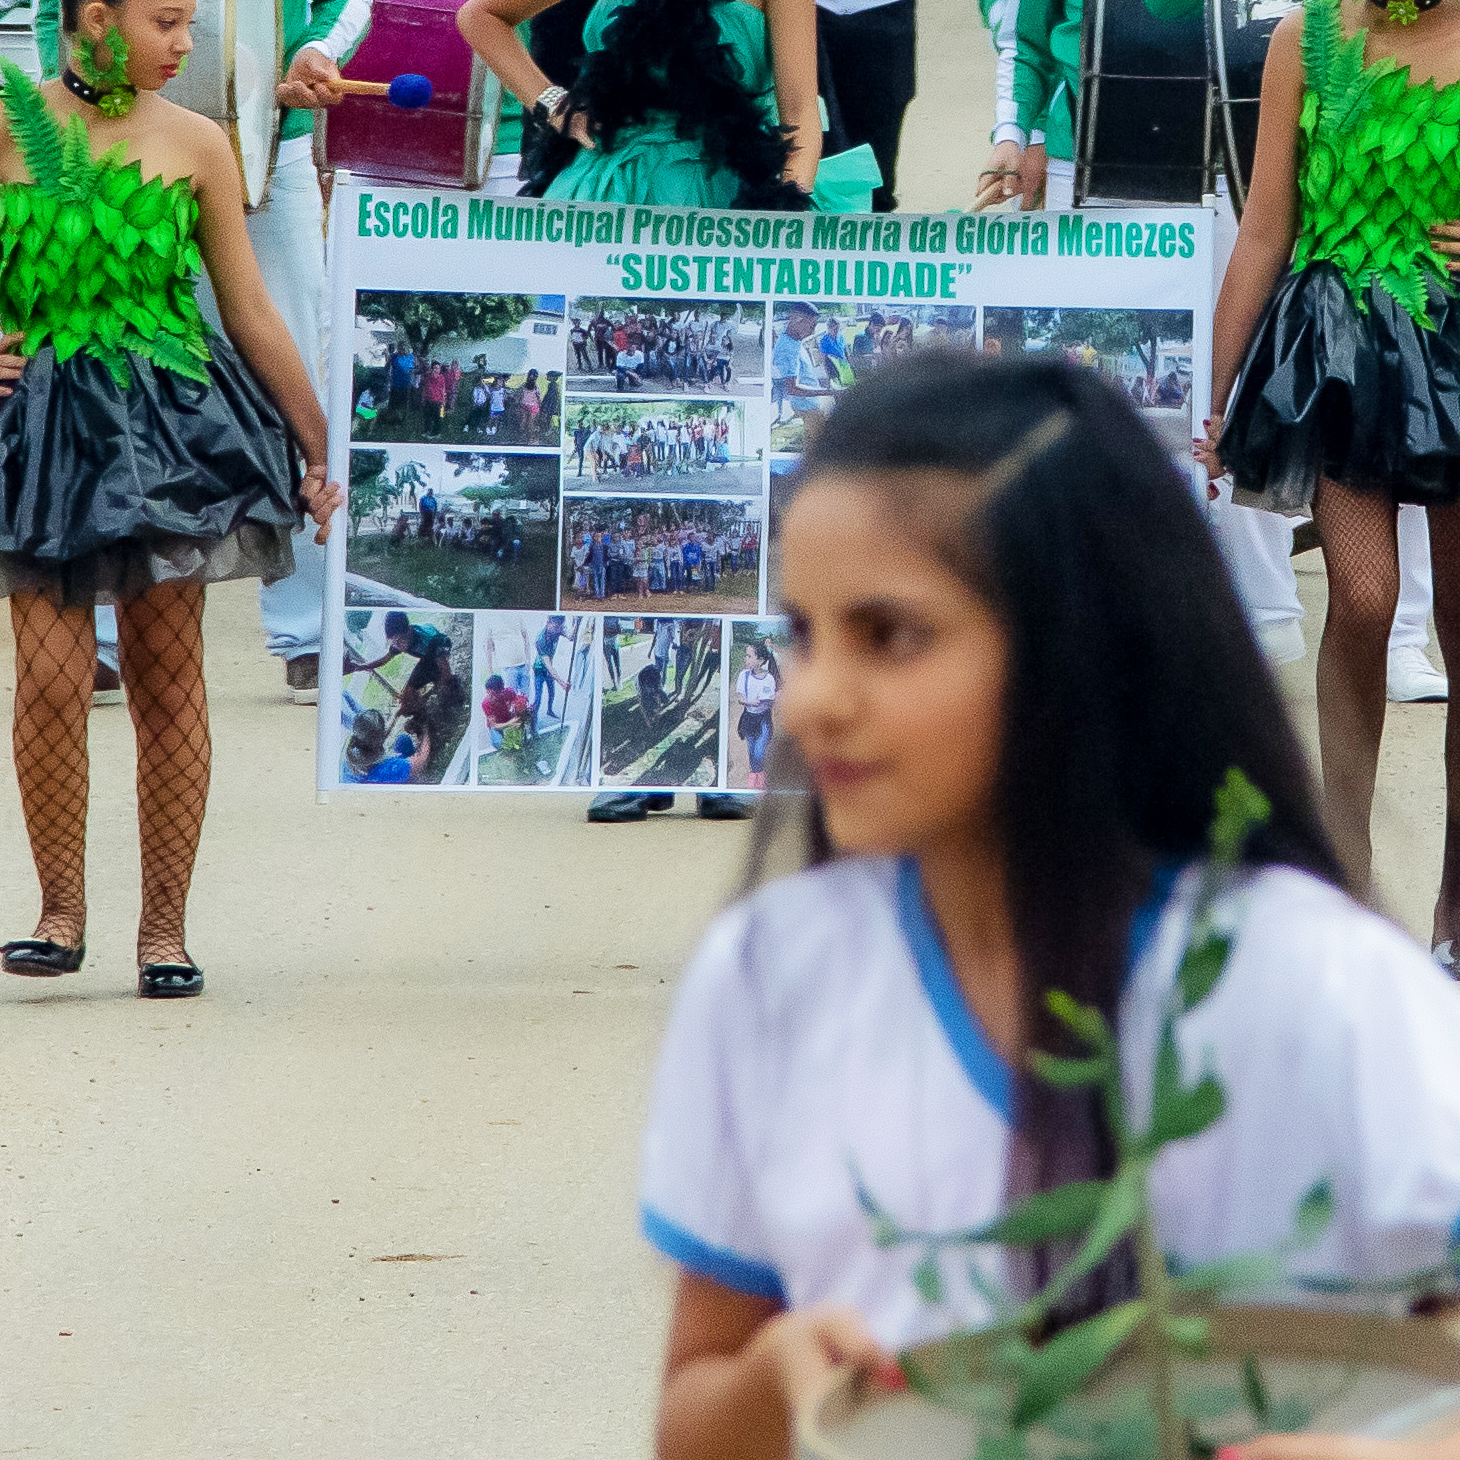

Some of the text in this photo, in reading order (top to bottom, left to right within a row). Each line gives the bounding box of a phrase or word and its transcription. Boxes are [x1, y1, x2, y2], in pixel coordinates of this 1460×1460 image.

[358, 193, 1195, 258] Escola Municipal Professora Maria da Glória Menezes
[607, 254, 972, 298] “SUSTENTABILIDADE”
